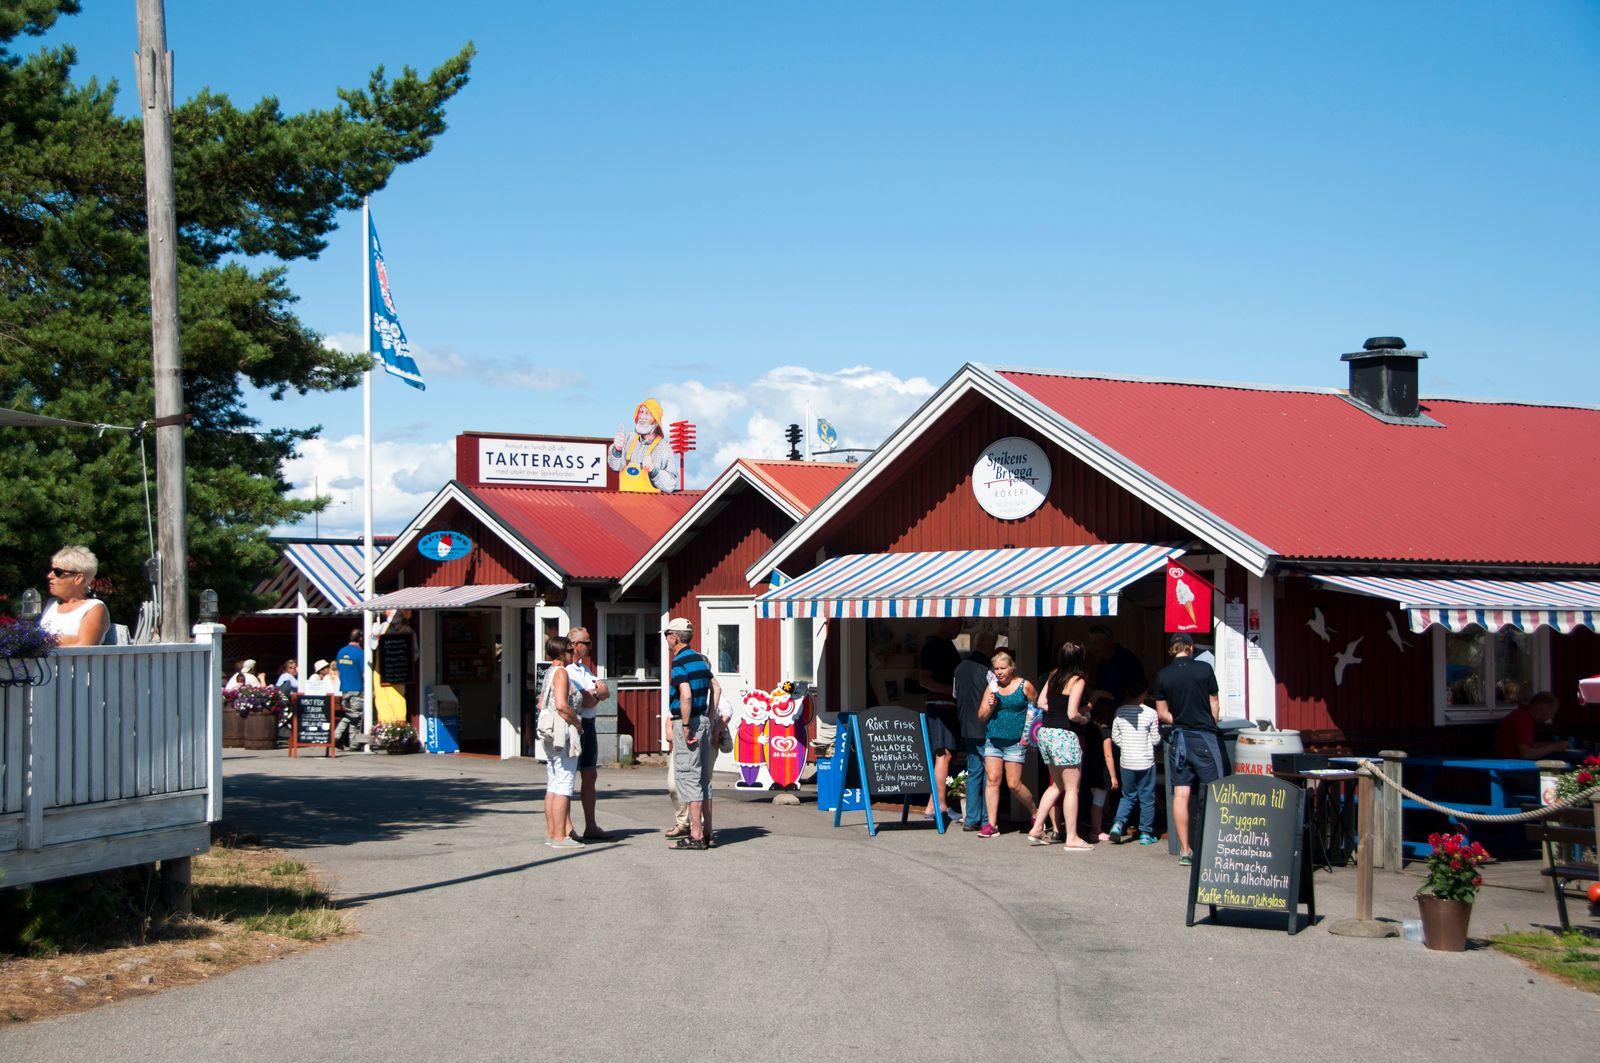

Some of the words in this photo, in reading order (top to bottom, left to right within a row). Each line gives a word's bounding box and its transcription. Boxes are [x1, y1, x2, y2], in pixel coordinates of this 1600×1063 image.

[486, 451, 585, 469] TAKTERASS
[987, 451, 1027, 470] Spikens
[995, 465, 1033, 482] Brygga
[865, 716, 890, 731] RÖKT
[893, 719, 916, 730] FISK
[867, 733, 914, 743] TALLRIKAR
[870, 744, 913, 753] SALLADER
[871, 751, 920, 761] SMÖRGÅSAR
[873, 762, 892, 771] FIKA
[1212, 783, 1266, 806] Välkomna
[1271, 788, 1286, 809] till
[1219, 806, 1266, 831] Bryggan
[1217, 829, 1270, 846] Laxtallrik
[1216, 843, 1272, 858] Specialpizza
